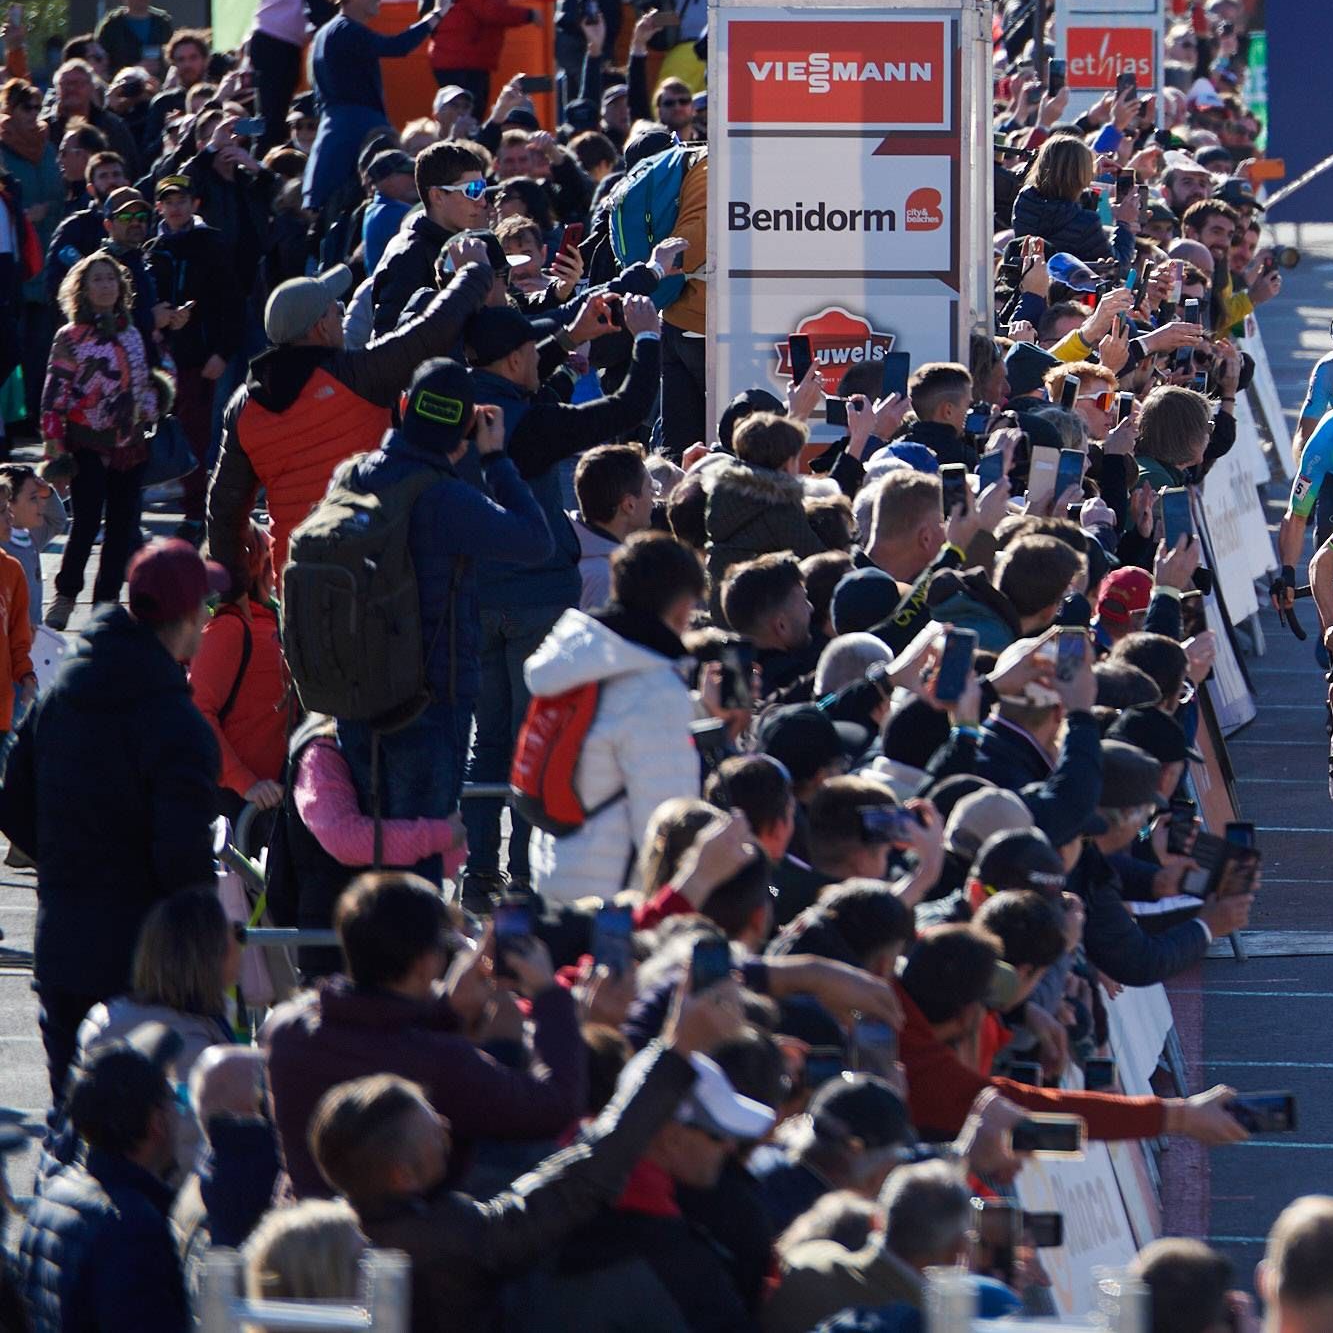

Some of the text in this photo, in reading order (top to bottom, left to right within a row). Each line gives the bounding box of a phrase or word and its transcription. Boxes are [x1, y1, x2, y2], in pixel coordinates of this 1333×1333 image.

[1069, 32, 1151, 83] ethias
[728, 201, 896, 232] Benidorm
[1295, 483, 1303, 495] 5
